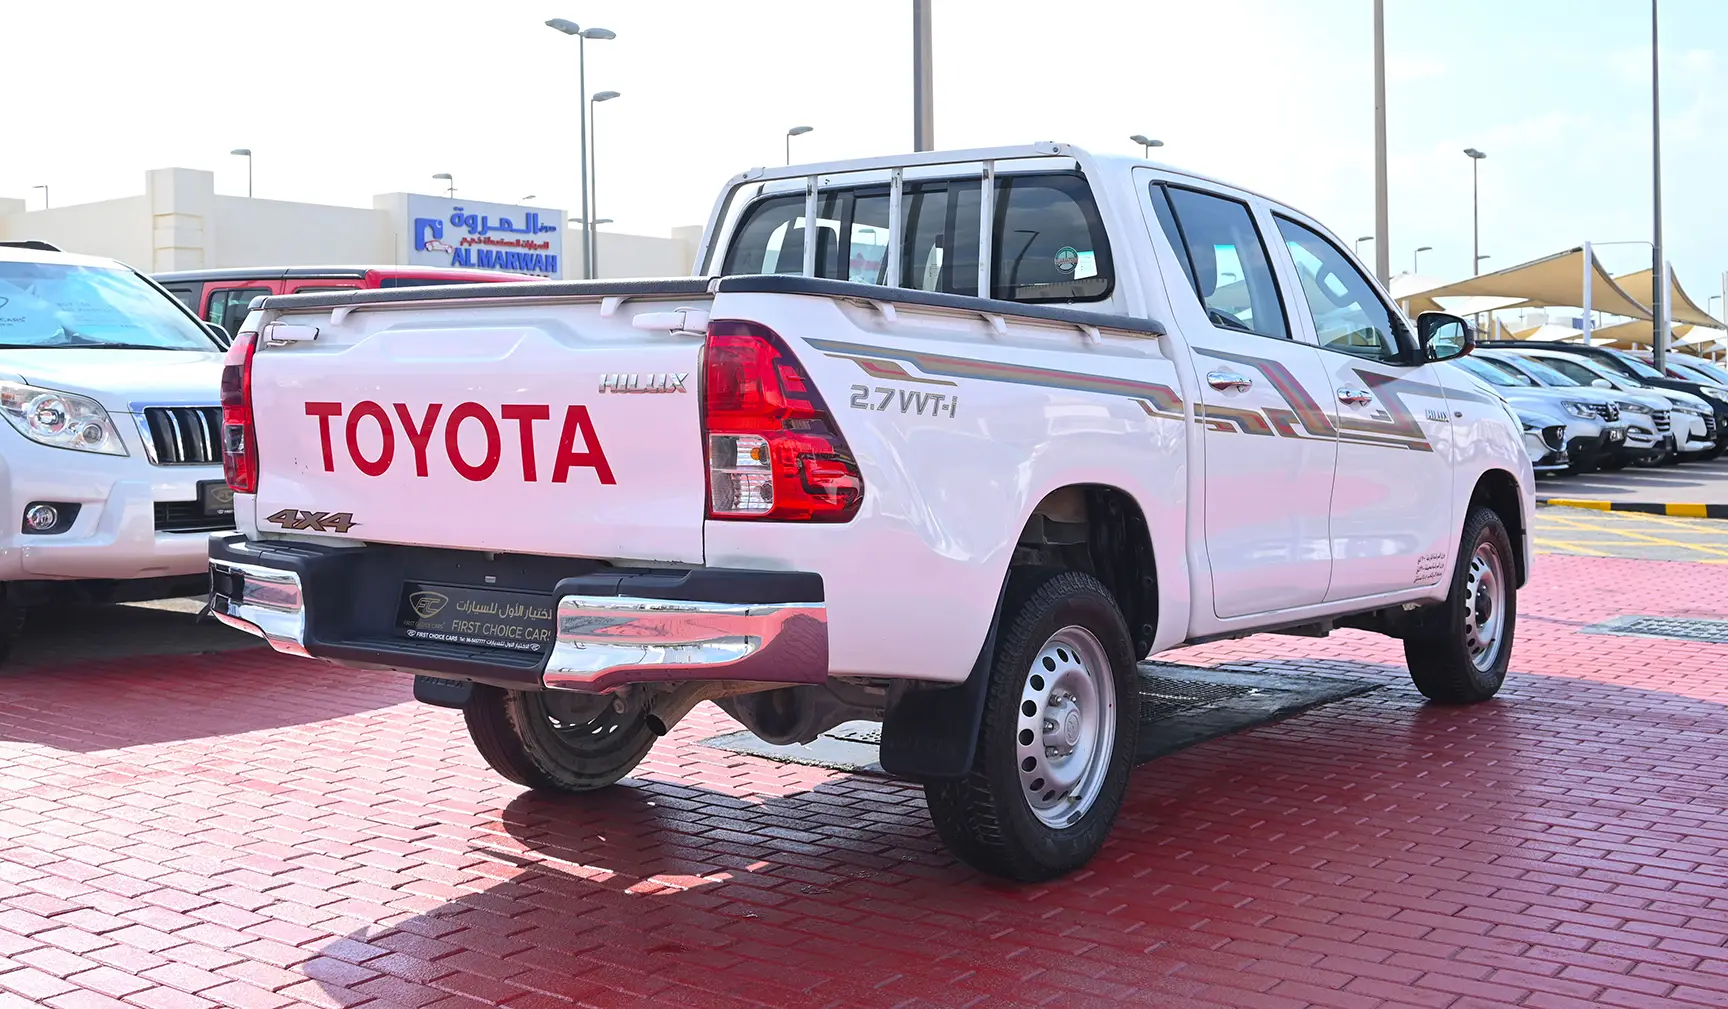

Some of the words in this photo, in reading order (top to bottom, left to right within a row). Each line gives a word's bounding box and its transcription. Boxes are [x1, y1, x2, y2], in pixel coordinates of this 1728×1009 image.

[451, 247, 476, 267] AL
[477, 249, 557, 273] MARWAH
[598, 371, 690, 395] HILUX
[850, 384, 896, 412] 2.7
[899, 389, 958, 419] VVT-i
[304, 400, 618, 486] TOYOTA
[456, 599, 498, 616] للسيارات
[445, 634, 458, 642] CARS
[452, 619, 481, 633] FIRST
[482, 622, 523, 639] CHOICE
